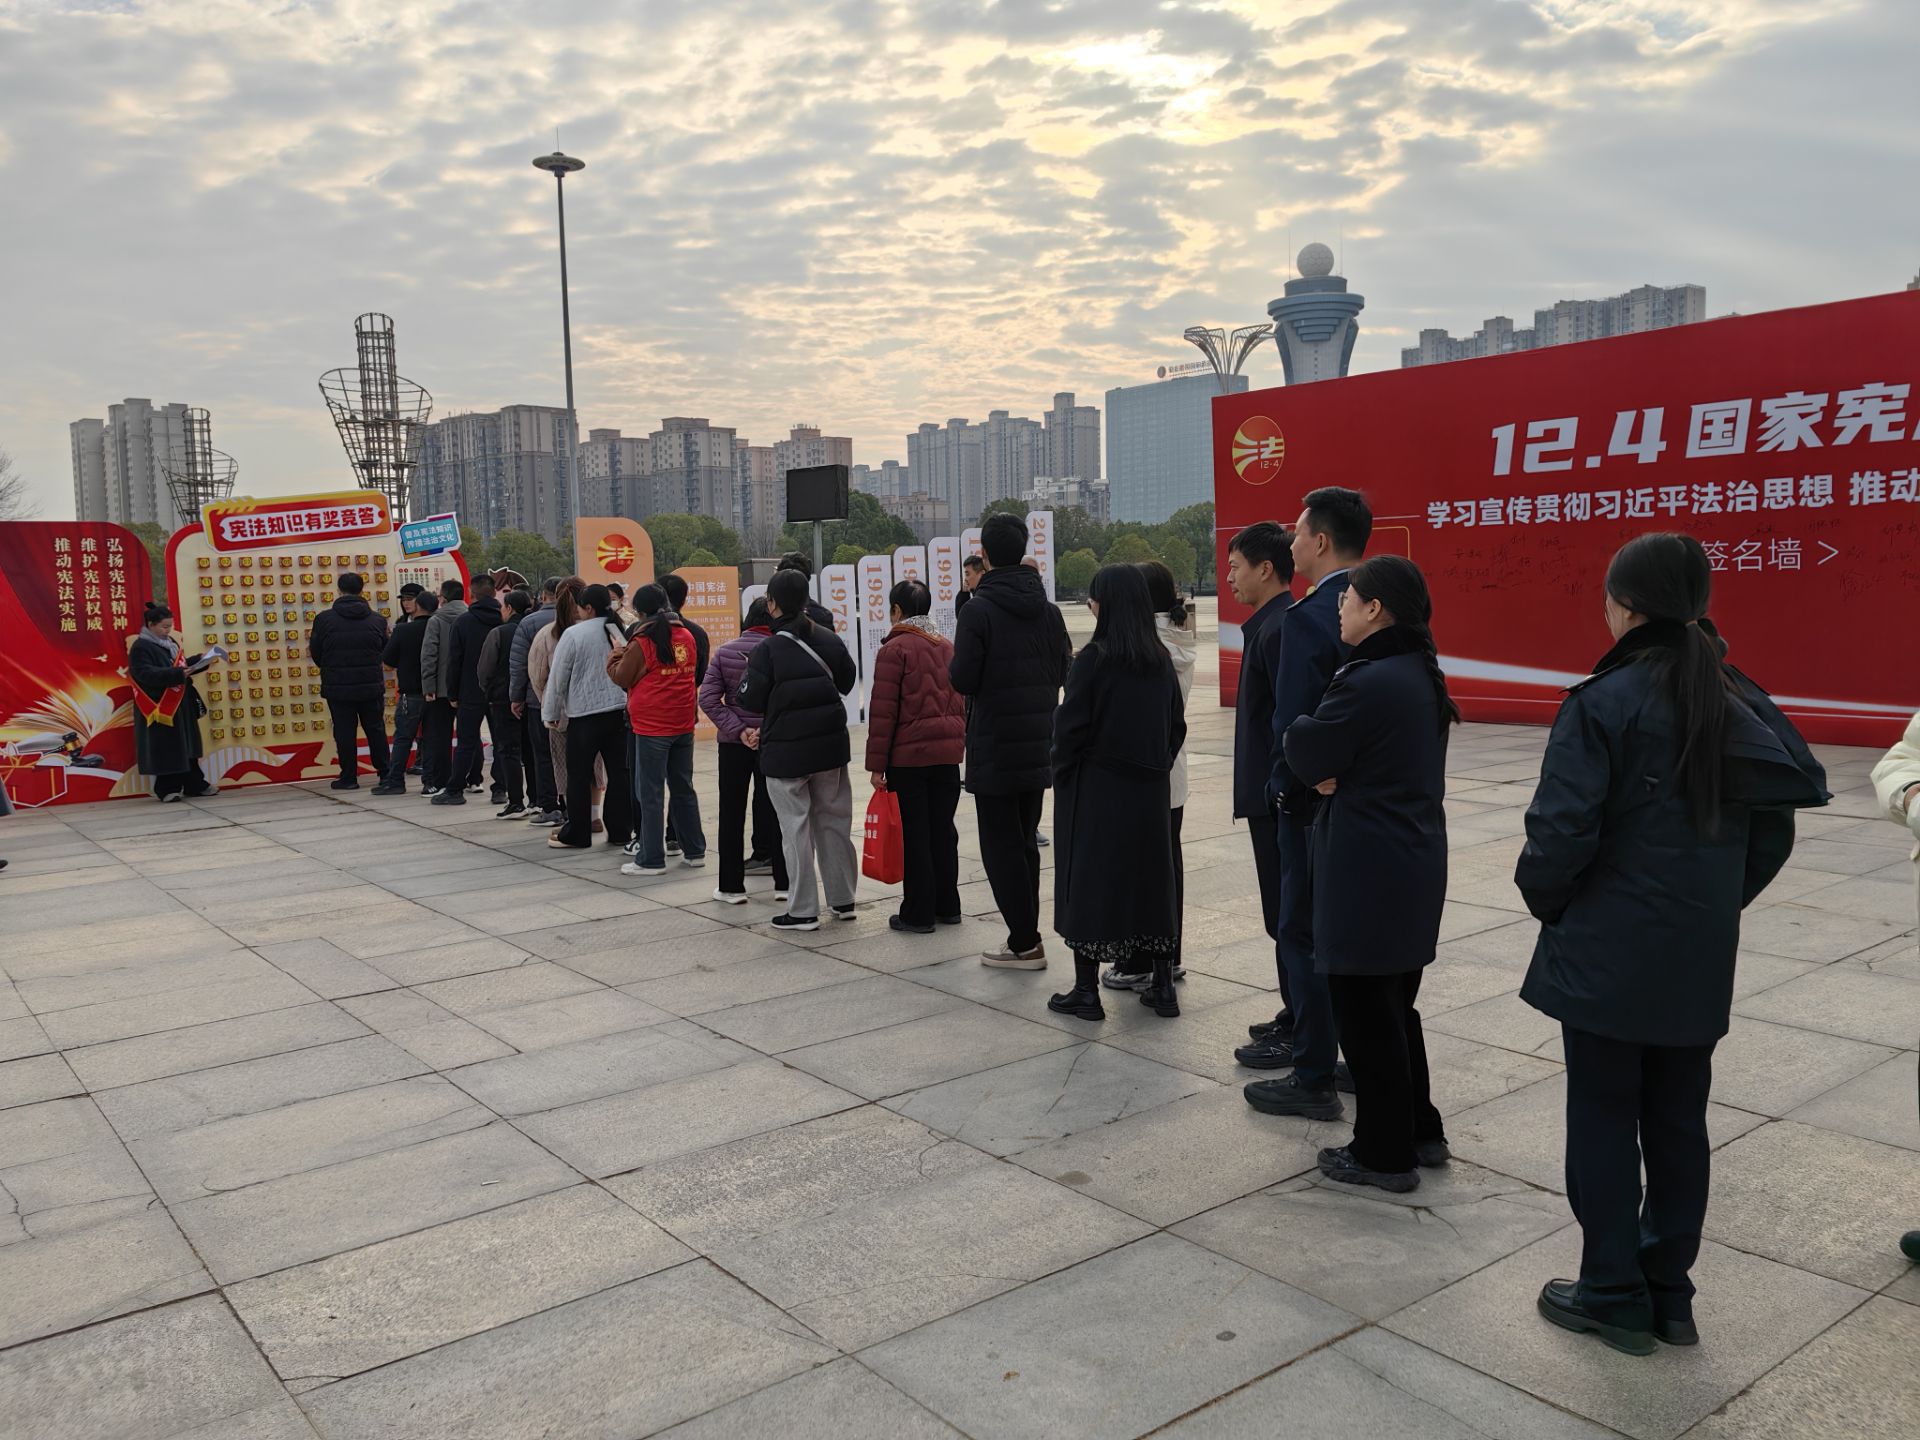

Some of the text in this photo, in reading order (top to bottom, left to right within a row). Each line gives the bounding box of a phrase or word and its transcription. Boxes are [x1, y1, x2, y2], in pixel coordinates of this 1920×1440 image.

[1491, 382, 1920, 476] 12.4 国家宪
[229, 507, 375, 539] 宪法知识有奖竞答
[1427, 467, 1920, 529] 学习宣传贯彻习近平法治思想 推动
[405, 523, 452, 539] 普及宪法知识
[54, 537, 77, 632] 推动宪法实施
[80, 537, 103, 631] 维护宪法权威
[106, 537, 128, 630] 弘扬宪法精神
[685, 594, 728, 607] 发展历程
[687, 581, 727, 594] 中国宪法
[829, 573, 849, 634] 1978
[865, 563, 885, 622] 1982
[936, 546, 953, 602] 1993
